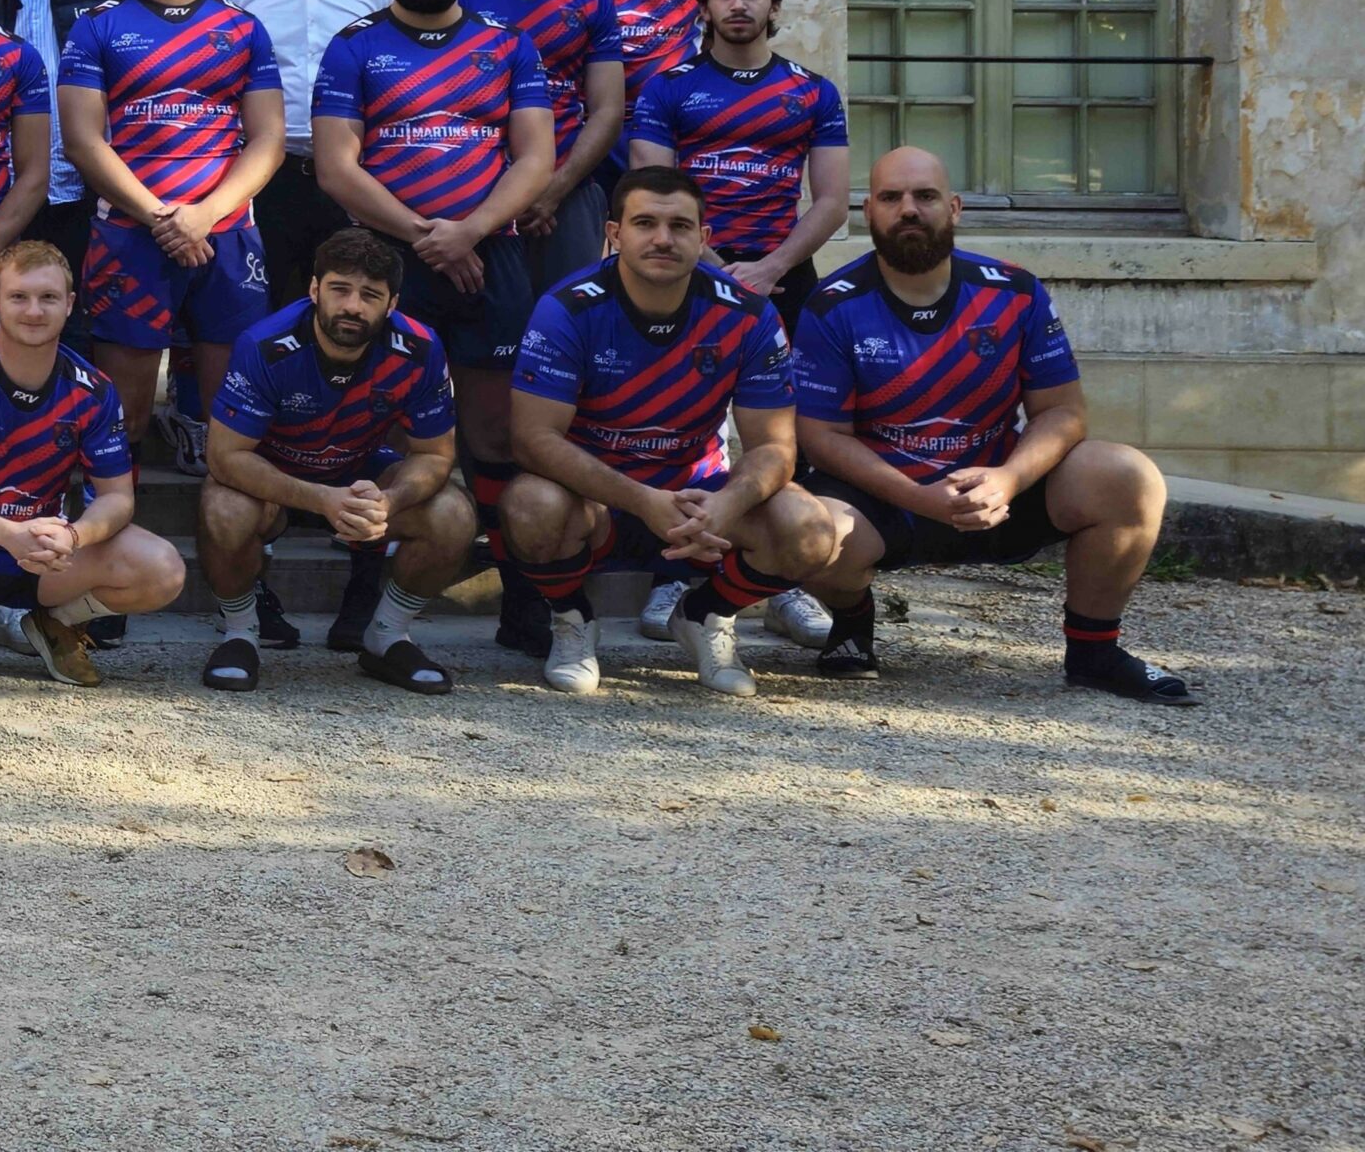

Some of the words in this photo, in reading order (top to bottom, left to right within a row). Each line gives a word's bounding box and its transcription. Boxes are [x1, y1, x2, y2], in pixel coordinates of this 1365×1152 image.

[154, 104, 204, 116] MARTINS
[413, 126, 468, 140] MARTINS
[471, 126, 478, 137] &
[481, 126, 499, 140] FILS
[913, 310, 937, 319] FXV
[649, 325, 675, 333] FXV
[494, 345, 516, 355] FXV
[13, 391, 39, 403] FXV
[618, 437, 679, 450] MARTINS
[905, 435, 967, 450] MARTINS
